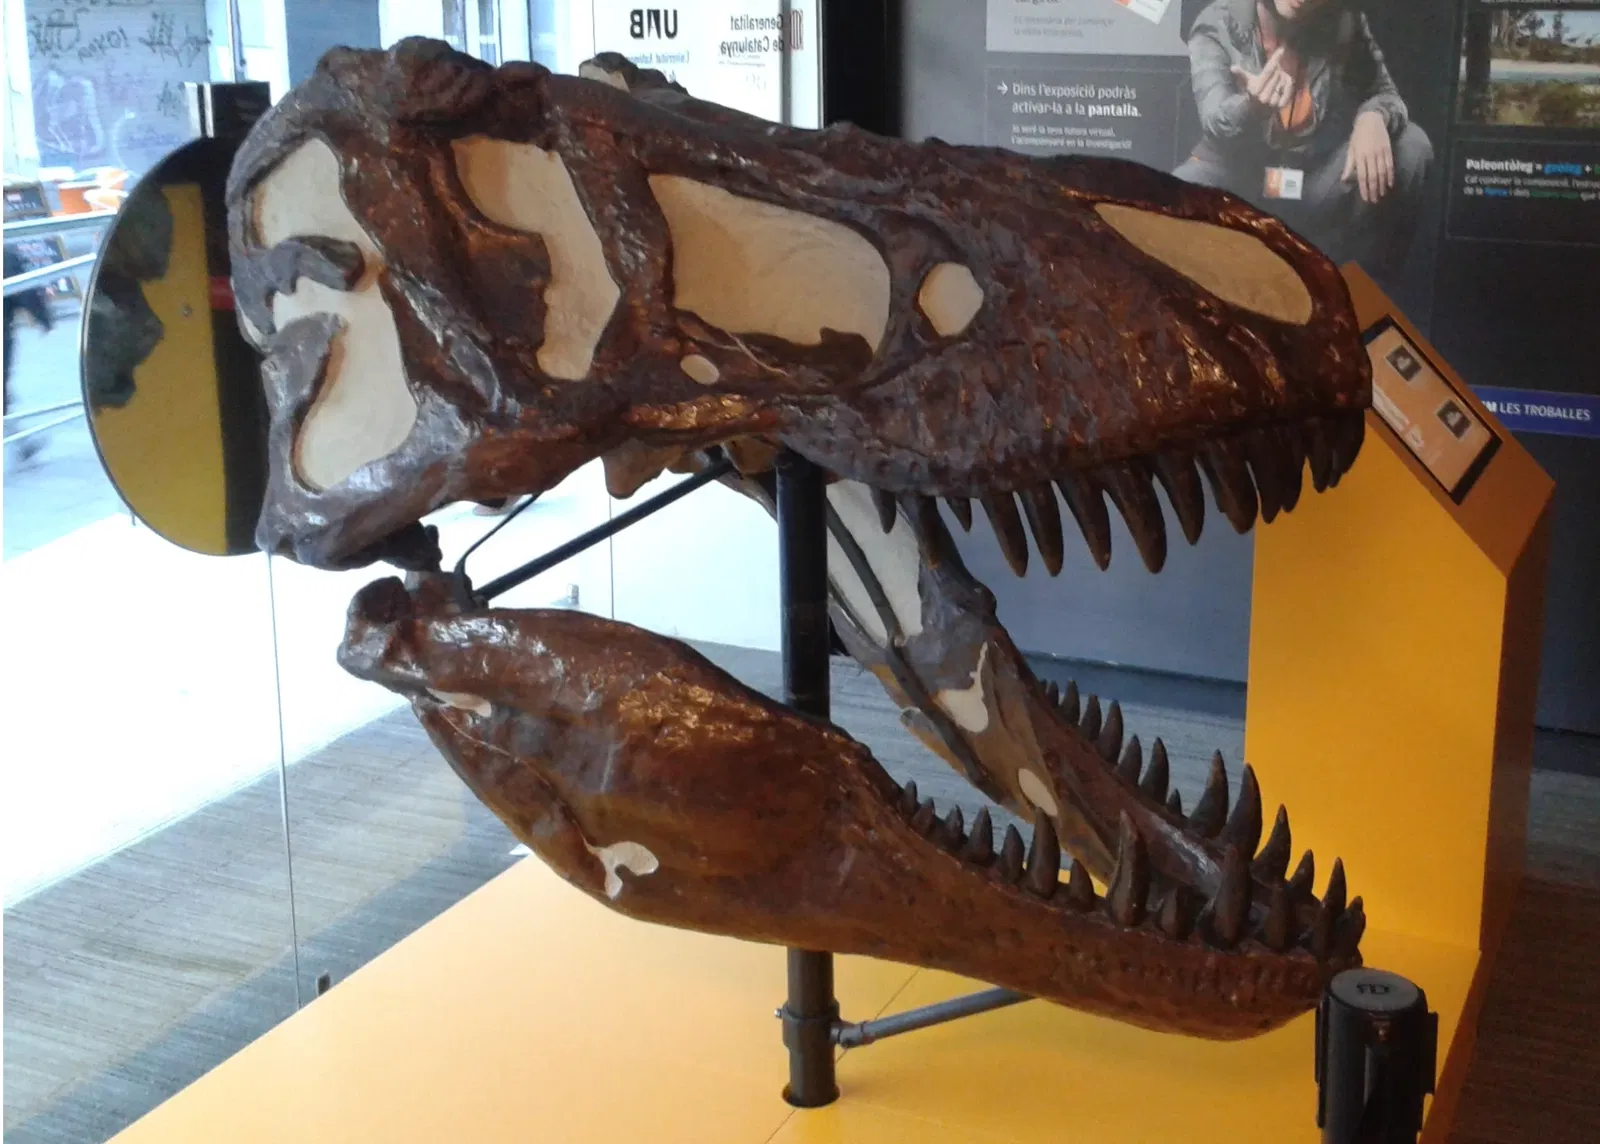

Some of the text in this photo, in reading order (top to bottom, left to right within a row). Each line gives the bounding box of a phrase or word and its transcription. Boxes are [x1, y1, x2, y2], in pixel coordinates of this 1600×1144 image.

[1012, 82, 1136, 100] Dins l'exposició podràs
[1012, 100, 1142, 118] activar-la a la pantalla.
[1500, 402, 1521, 415] LES
[1524, 404, 1591, 421] TROBALLES
